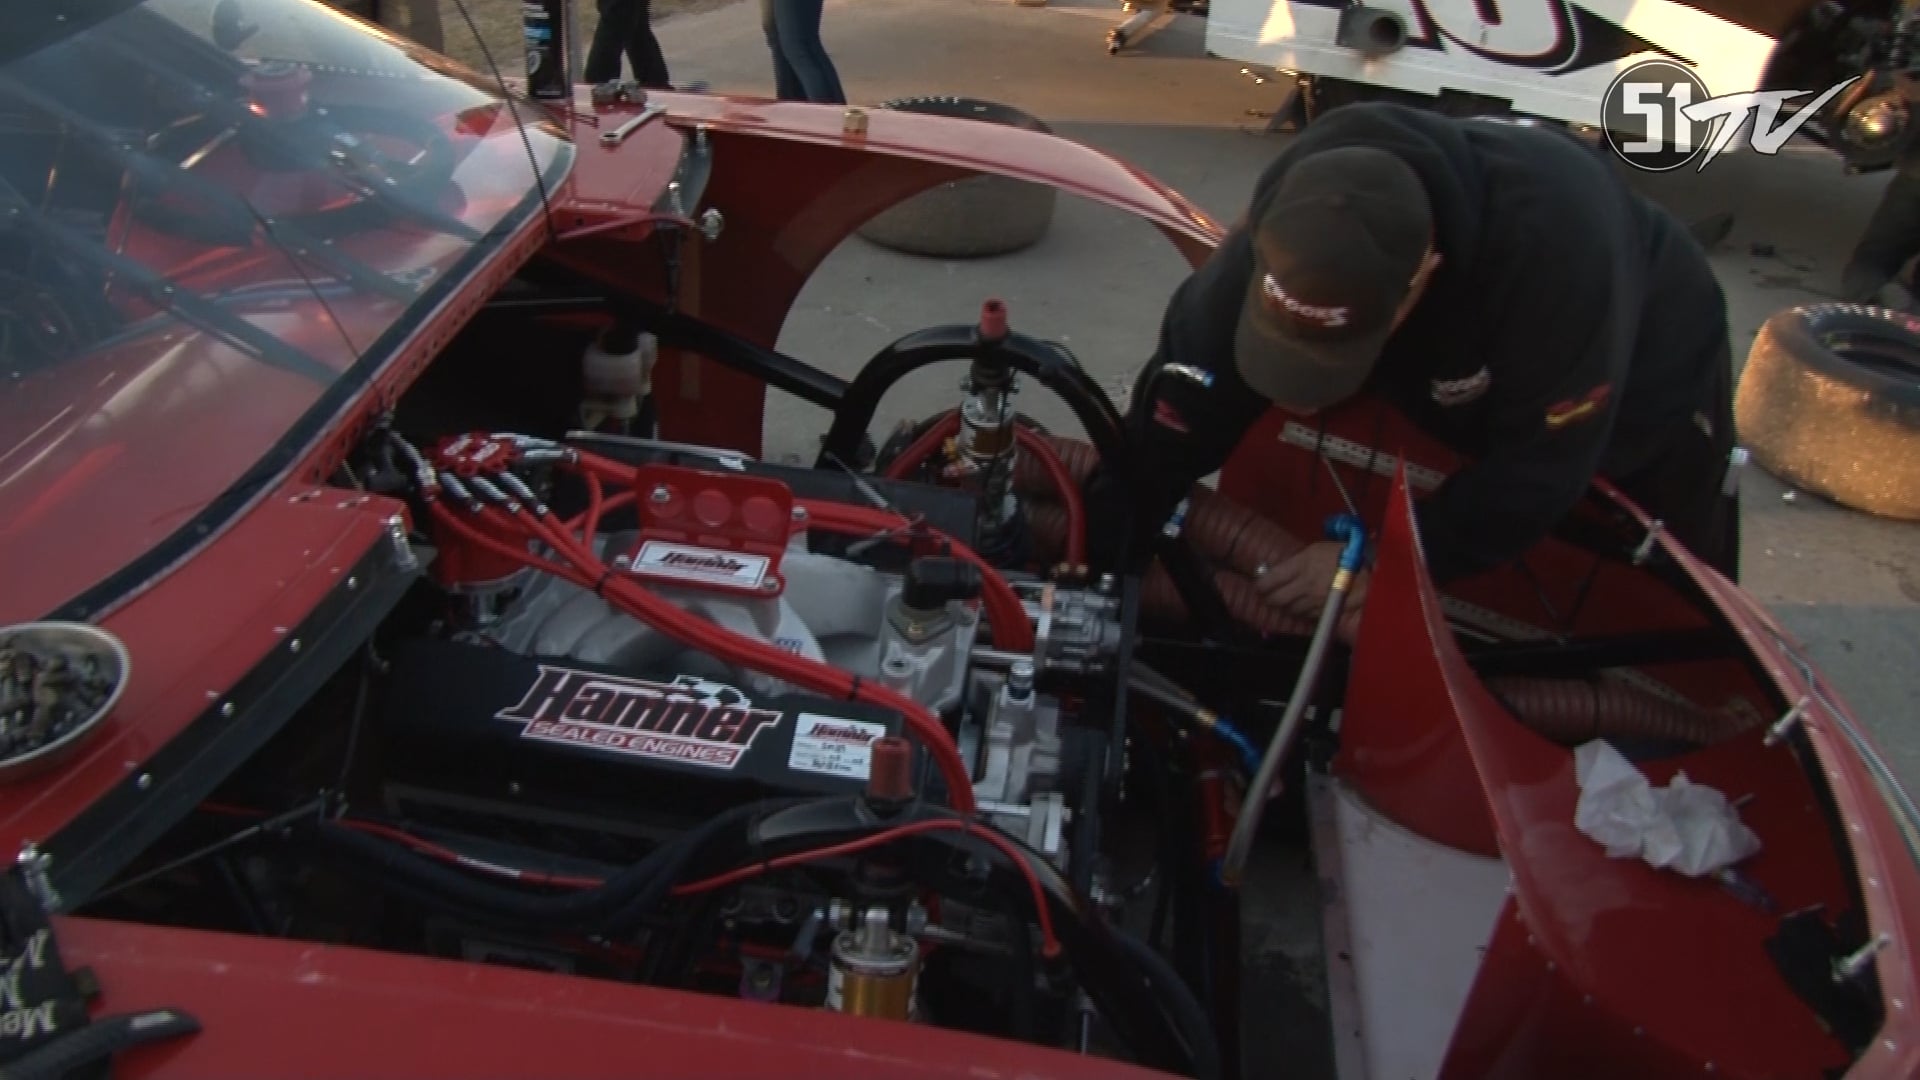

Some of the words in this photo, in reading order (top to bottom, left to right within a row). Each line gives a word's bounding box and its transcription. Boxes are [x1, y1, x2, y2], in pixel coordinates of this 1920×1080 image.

[495, 666, 783, 748] Hamner
[532, 719, 627, 747] SEALED
[627, 736, 733, 763] ENGINES
